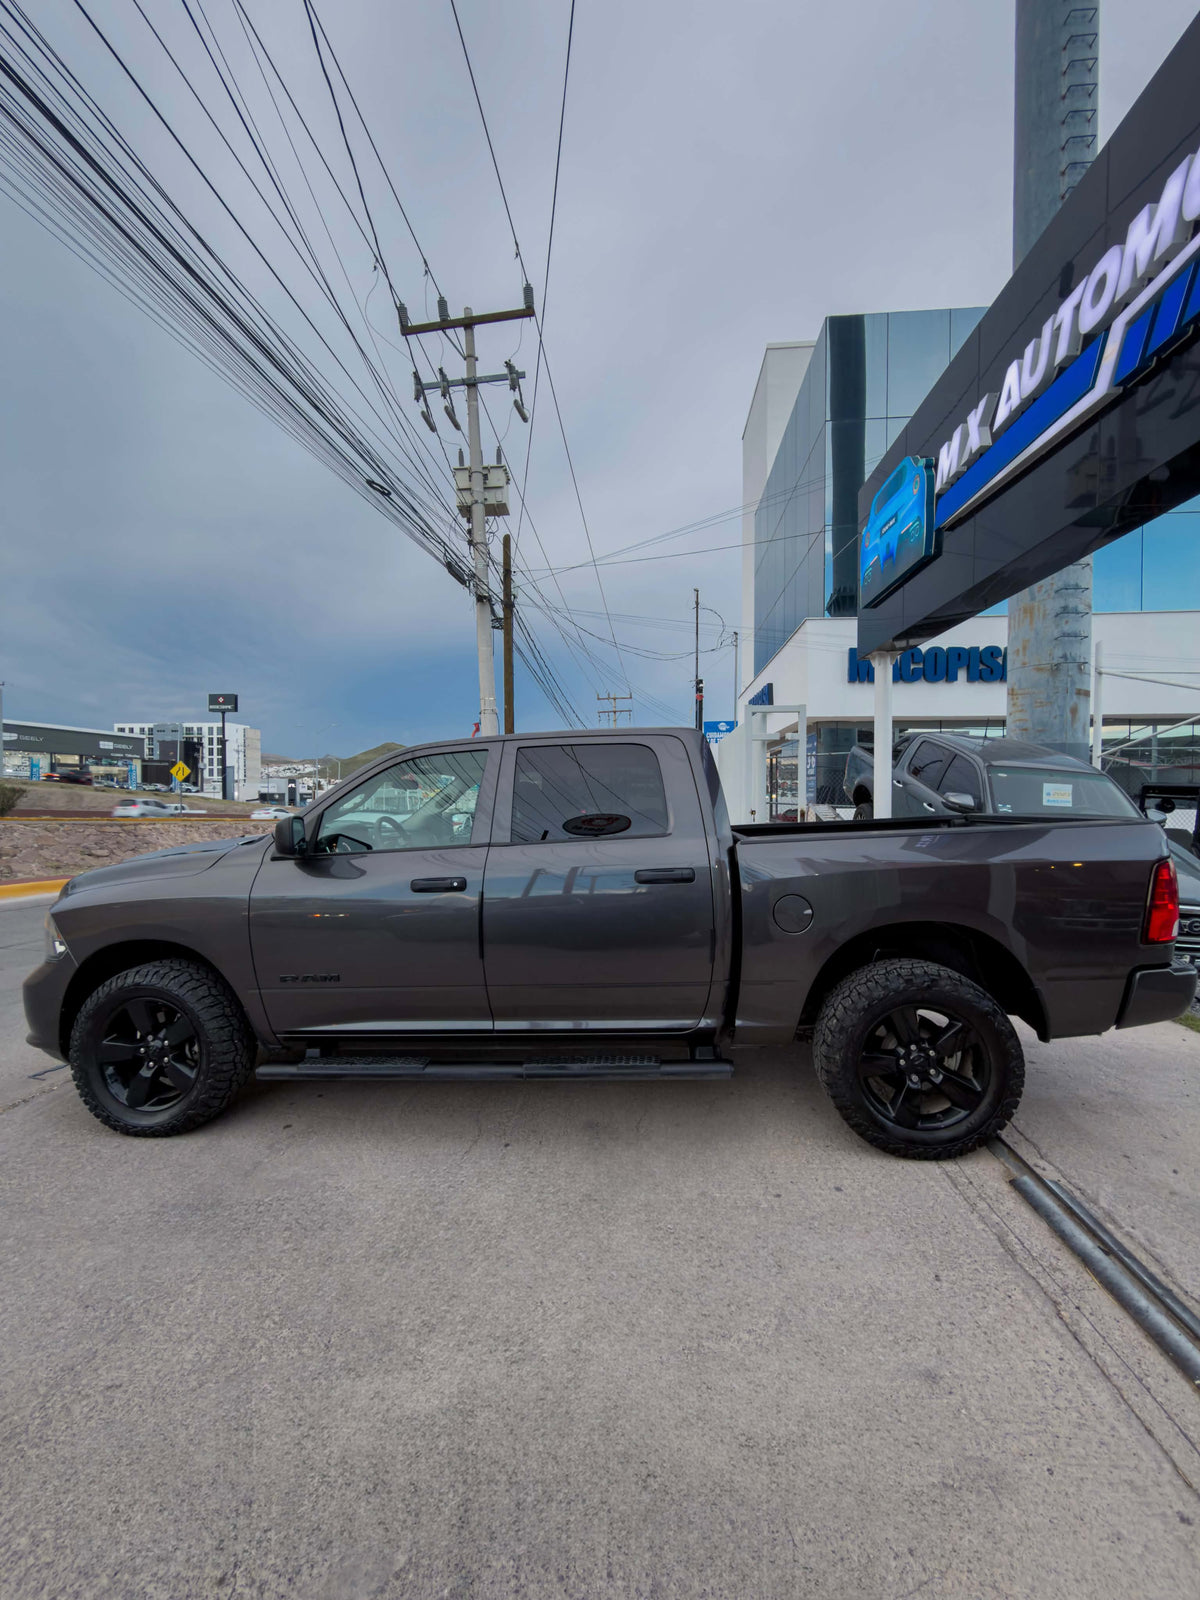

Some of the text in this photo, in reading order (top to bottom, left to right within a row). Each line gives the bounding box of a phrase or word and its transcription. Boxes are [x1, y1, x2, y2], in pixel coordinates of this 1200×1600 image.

[936, 392, 995, 494] MX
[848, 645, 1007, 683] MCOPIS
[19, 734, 44, 742] GEELY
